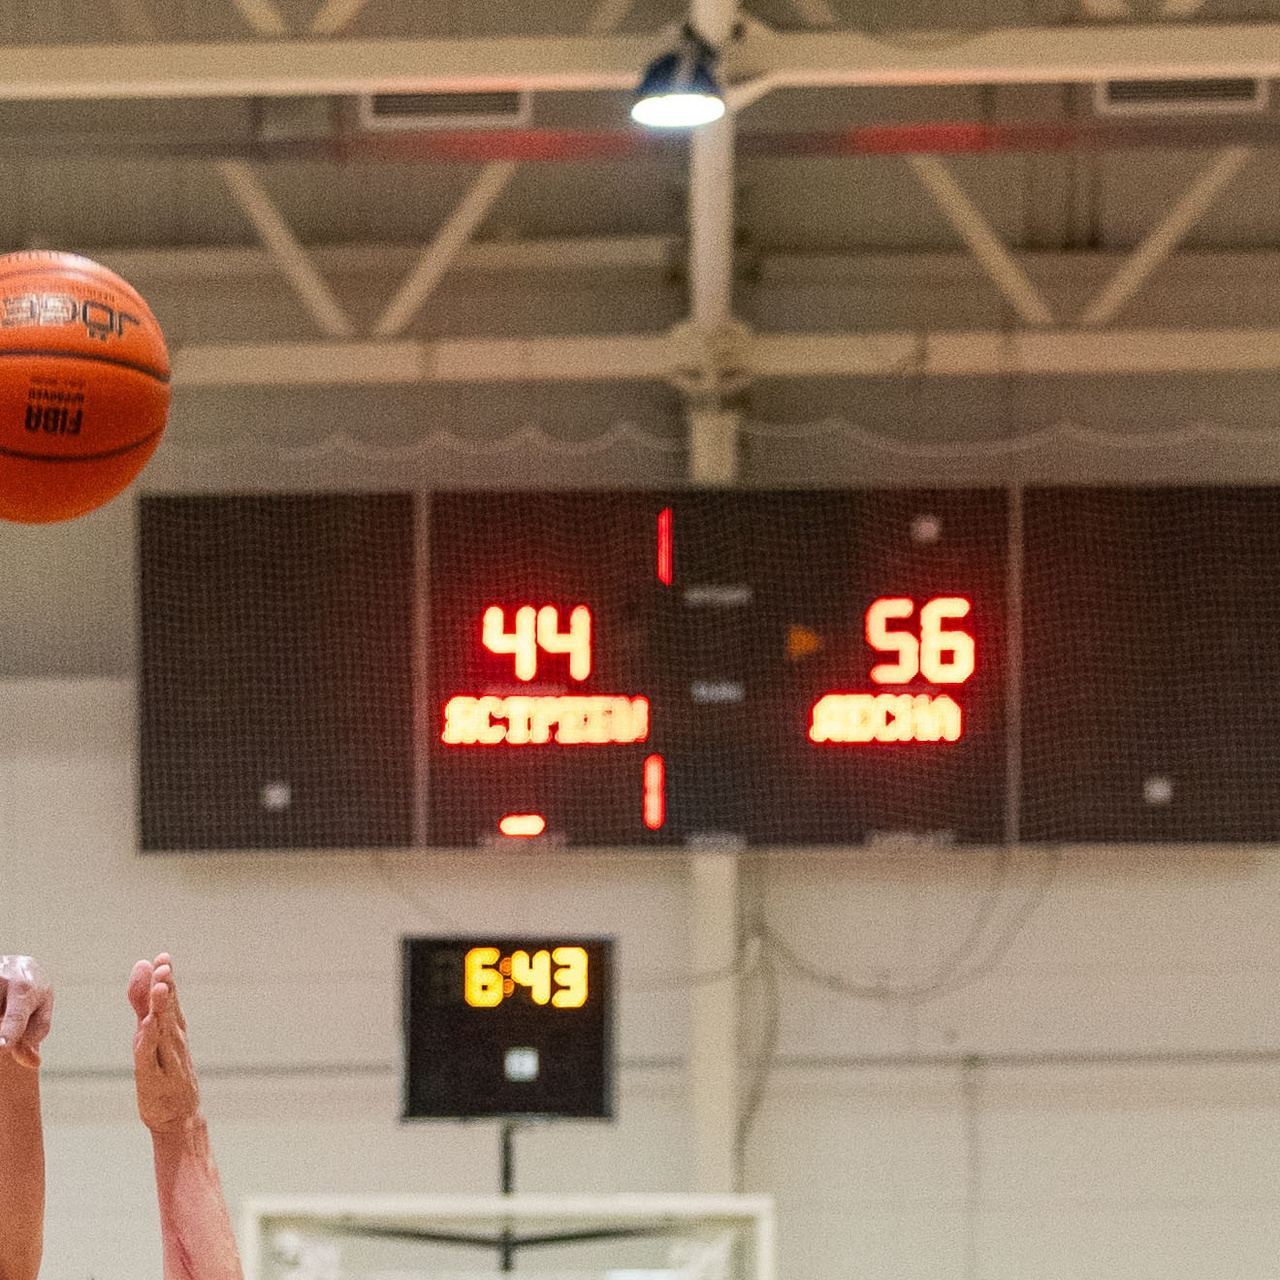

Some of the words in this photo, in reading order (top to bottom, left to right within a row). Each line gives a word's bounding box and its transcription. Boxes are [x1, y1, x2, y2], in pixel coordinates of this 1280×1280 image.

[24, 406, 84, 436] FIBA
[481, 604, 593, 682] 44
[865, 596, 977, 685] 56
[464, 946, 589, 1009] 6:43
